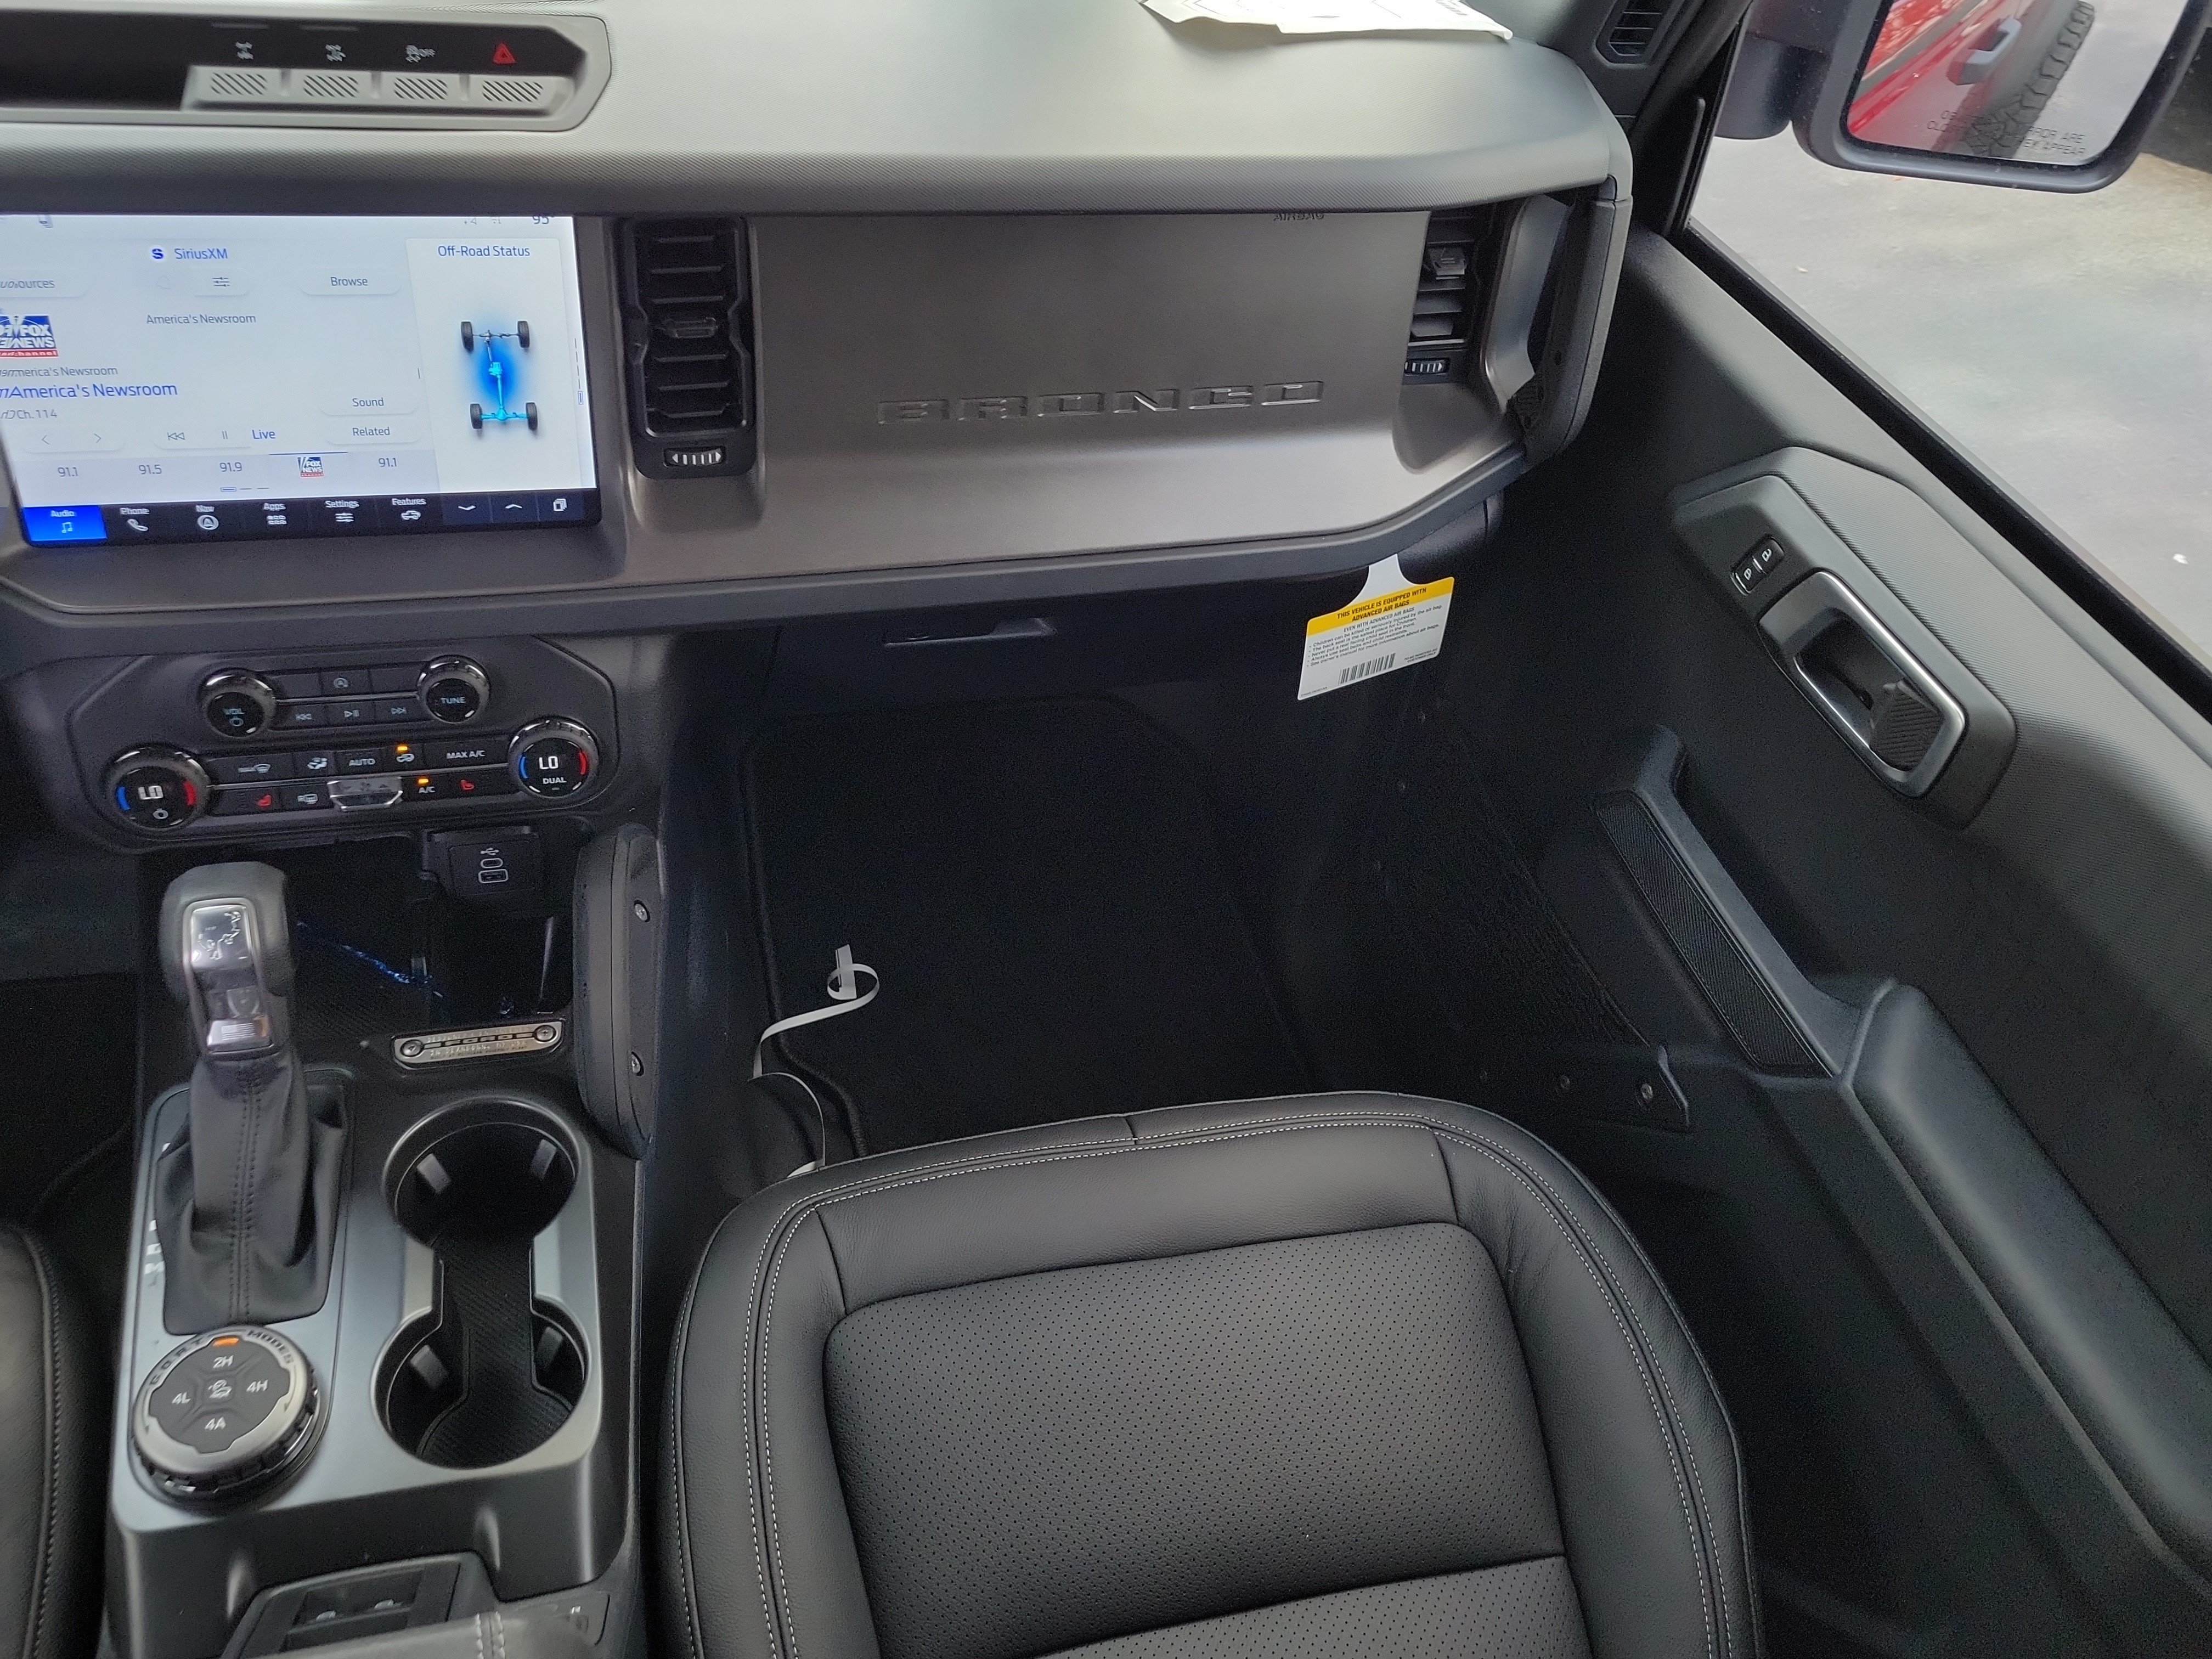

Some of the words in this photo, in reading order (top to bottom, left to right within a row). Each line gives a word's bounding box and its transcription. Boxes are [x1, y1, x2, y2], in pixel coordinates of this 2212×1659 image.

[174, 248, 228, 259] SiriusXM
[438, 246, 490, 257] Off-Road
[493, 246, 530, 257] Status
[15, 279, 55, 289] ources
[330, 276, 368, 286] Browse
[146, 314, 199, 324] America's
[200, 313, 256, 324] Newsroom
[20, 324, 52, 336] FOX
[60, 366, 118, 376] Newsroom
[9, 385, 89, 399] America's
[93, 383, 178, 397] Newsroom
[352, 398, 384, 408] Sound
[878, 381, 1324, 425] BRONCO
[36, 409, 58, 419] 114
[252, 429, 275, 440] Live
[352, 427, 391, 437] Related
[219, 462, 242, 472] 91.9
[379, 458, 398, 467] 91.1
[58, 467, 78, 477] 91.1
[138, 465, 162, 475] 91.5
[263, 503, 286, 511] Apps
[325, 500, 360, 509] Settings
[392, 498, 426, 506] Features
[120, 507, 150, 516] Phone
[1338, 611, 1350, 619] THIS
[1352, 603, 1375, 614] VEHICLE
[1383, 592, 1410, 605] EQUIPPED
[1412, 588, 1426, 596] WITH
[1352, 608, 1382, 621] ADVANCED
[1395, 600, 1409, 608] BAGS
[1370, 614, 1393, 624] ADVANCED
[446, 752, 467, 760] MAX
[468, 750, 486, 758] A/C
[349, 758, 376, 766] AUTO
[539, 756, 559, 770] LO
[542, 776, 567, 785] DUAL
[419, 786, 436, 794] A/C
[246, 1329, 295, 1364] MODES
[213, 1355, 234, 1368] 2H
[246, 1379, 268, 1392] 4H
[172, 1392, 191, 1404] 4L
[204, 1417, 227, 1430] 4A
